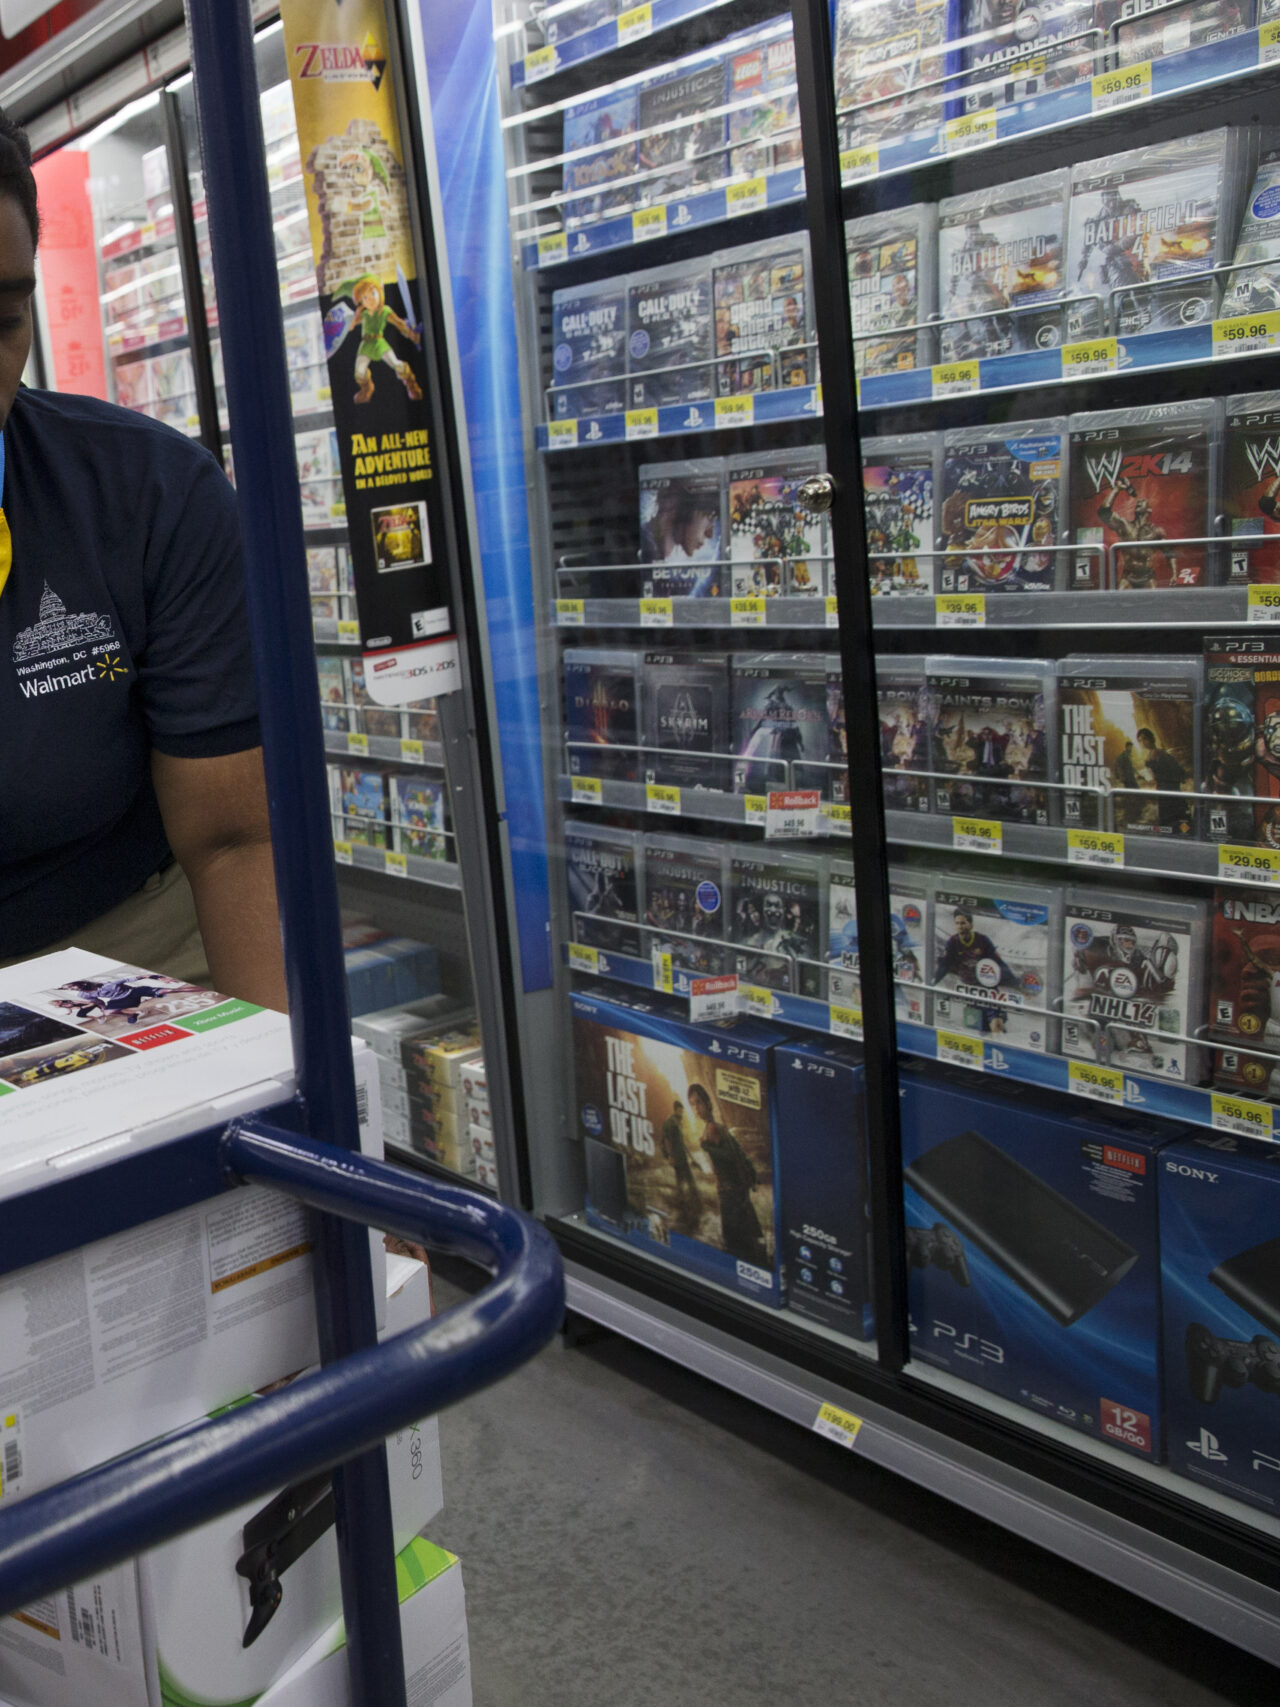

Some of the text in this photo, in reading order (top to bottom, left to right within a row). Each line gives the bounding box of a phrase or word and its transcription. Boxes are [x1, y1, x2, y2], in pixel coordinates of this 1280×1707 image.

[295, 44, 367, 78] ZELDA
[1101, 73, 1142, 94] $59.96
[1089, 174, 1126, 190] PS3
[1084, 200, 1199, 246] BATTLEFIELD
[952, 234, 1048, 276] BATTLEFIELD
[1132, 238, 1146, 261] 4
[992, 269, 1005, 289] 4
[639, 297, 664, 317] CALL
[1223, 323, 1267, 342] $59.96
[1071, 347, 1108, 363] $59.96
[939, 370, 972, 385] $59.96
[351, 428, 429, 456] AN ALL-NEW
[1085, 430, 1119, 442] PS3
[958, 444, 988, 456] PS3
[354, 446, 431, 477] ADVENTURE
[1122, 451, 1193, 477] 2K14
[356, 479, 366, 490] IN
[375, 472, 408, 488] BELOVED
[409, 468, 433, 482] WORLD
[969, 502, 1030, 519] ANGRY BIRDS
[946, 602, 978, 615] $39.96
[1225, 641, 1265, 652] PS3
[16, 640, 121, 677] Washington, DC #5968
[407, 663, 429, 678] 3DS
[435, 659, 456, 672] 2DS
[19, 664, 97, 699] Walmart
[940, 676, 970, 688] PS3
[1073, 679, 1107, 689] PS3
[995, 696, 1034, 709] ROW
[660, 715, 709, 731] SKYRIM
[1062, 704, 1094, 735] THE
[1062, 735, 1106, 766] LAST
[960, 824, 992, 838] $49.96
[1079, 838, 1115, 852] $59.96
[1229, 853, 1270, 869] $29.96
[742, 875, 808, 896] INJUSTICE
[1081, 909, 1113, 921] PS3
[1114, 973, 1133, 986] EA
[131, 1028, 176, 1046] NETFLIX
[605, 1035, 636, 1079] THE
[726, 1044, 761, 1064] PS3
[806, 1062, 836, 1078] PS3
[1080, 1072, 1115, 1089] $59.96
[607, 1071, 647, 1119] LAST
[1222, 1104, 1263, 1124] $59.96
[610, 1108, 630, 1147] OF
[630, 1112, 656, 1157] US
[1107, 1150, 1140, 1169] NETFLIX
[1165, 1160, 1220, 1184] SONY
[933, 1319, 1005, 1365] PS3
[823, 1410, 856, 1435] $199.00
[1111, 1406, 1138, 1433] 12
[1105, 1422, 1146, 1447] GB/GO
[409, 1436, 424, 1481] 360
